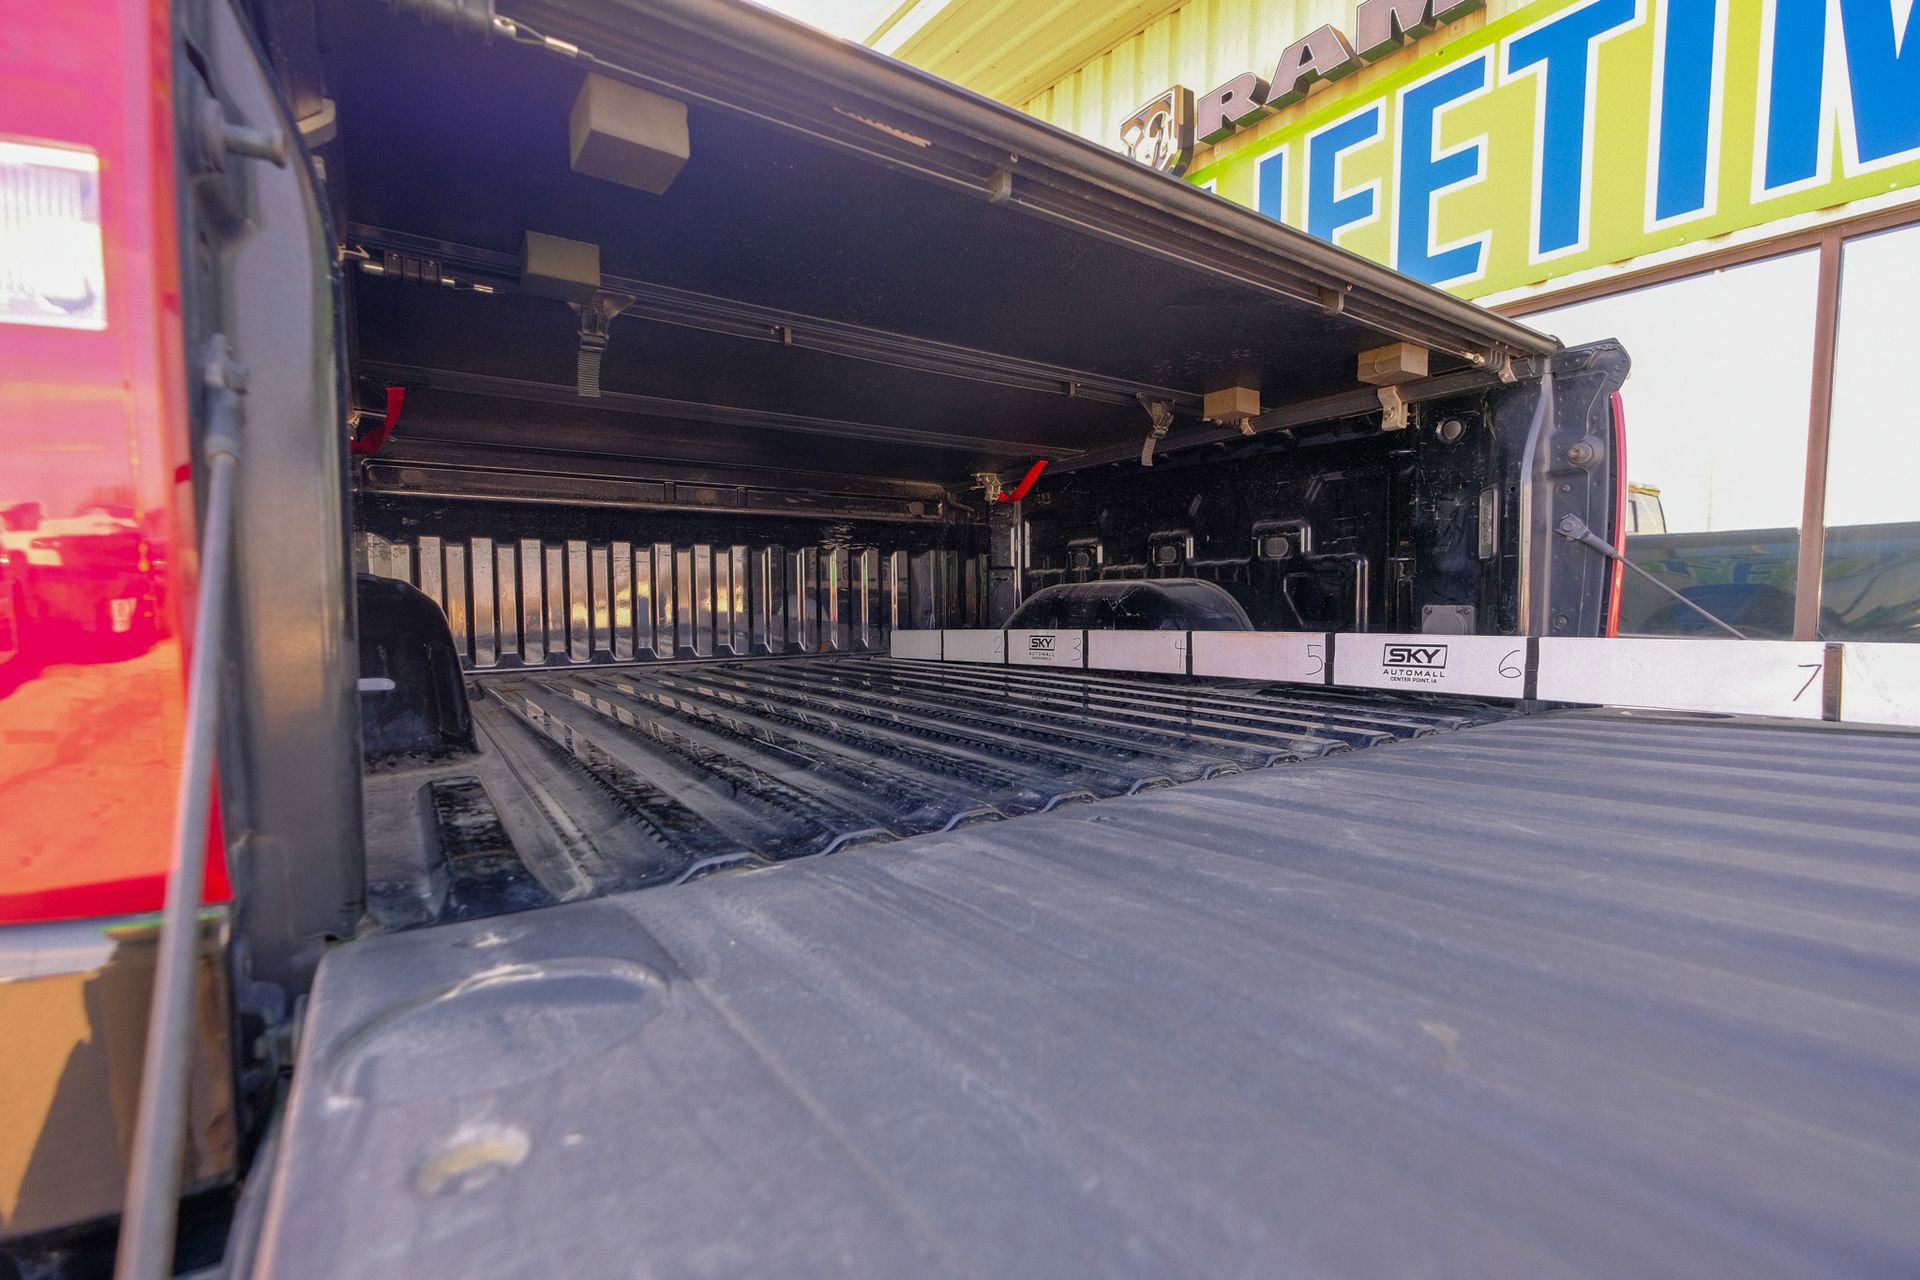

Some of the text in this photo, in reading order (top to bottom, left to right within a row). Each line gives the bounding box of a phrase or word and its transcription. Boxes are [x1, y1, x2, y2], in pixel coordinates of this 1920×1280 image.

[993, 636, 1004, 654] 2
[1031, 638, 1053, 648] SKY
[1071, 637, 1082, 662] 3
[1174, 638, 1186, 669] 4
[1305, 644, 1323, 676] 5
[1388, 648, 1441, 664] SKY
[1498, 649, 1522, 679] 6
[1383, 669, 1445, 678] AUTOMALL
[1792, 664, 1822, 701] 7
